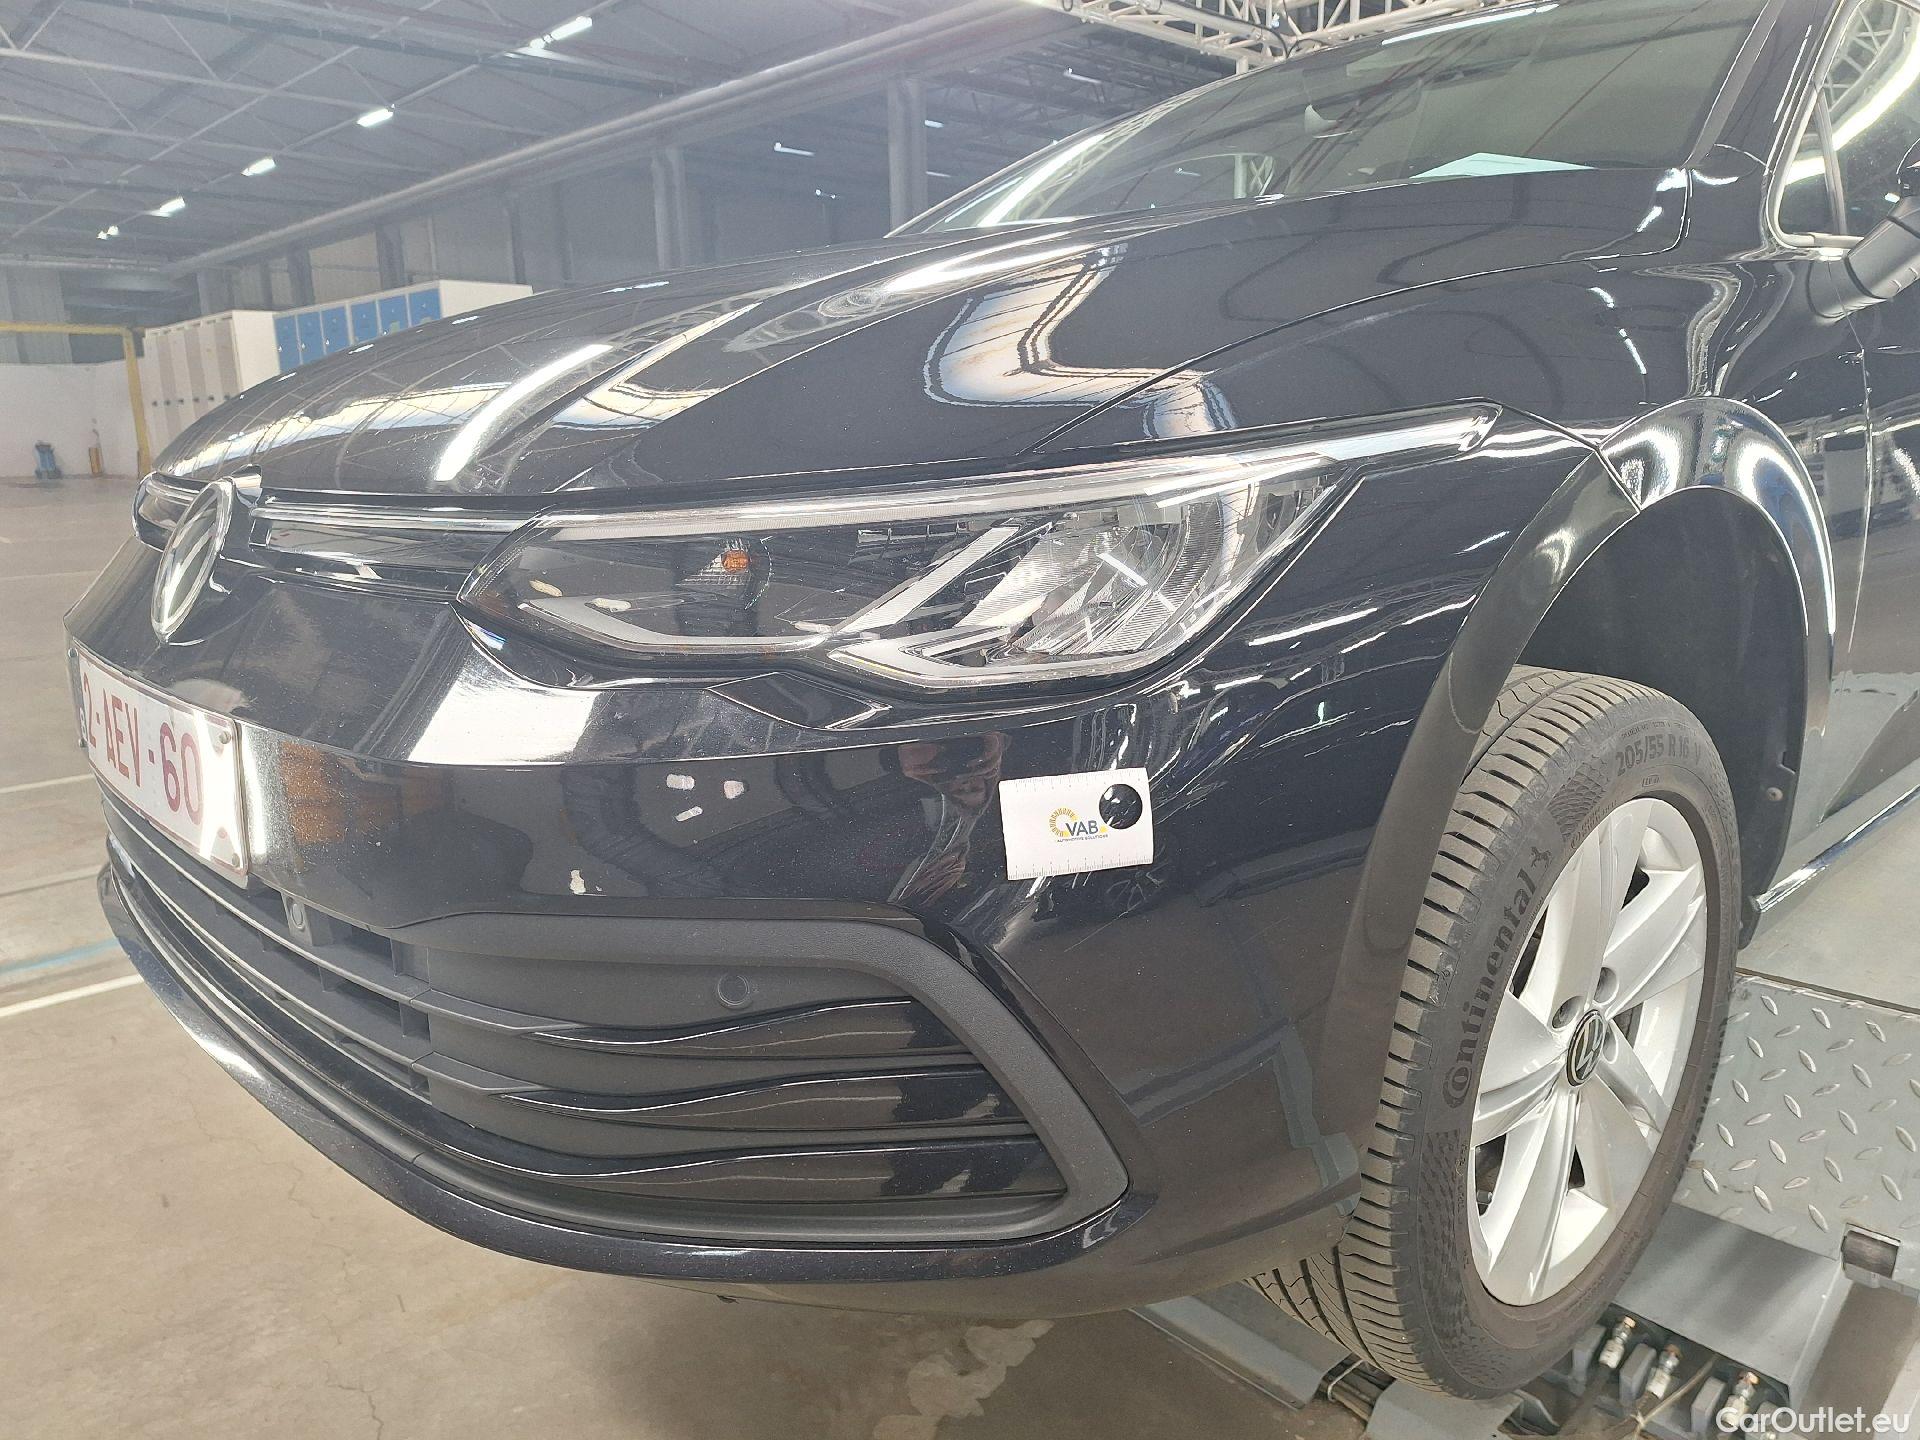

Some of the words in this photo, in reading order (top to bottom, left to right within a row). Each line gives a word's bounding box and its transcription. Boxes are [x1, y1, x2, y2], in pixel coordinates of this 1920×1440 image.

[84, 672, 204, 827] 2-AEV-60
[1616, 734, 1664, 776] 205/55
[1065, 820, 1098, 836] VAB
[1443, 868, 1537, 1109] Continental
